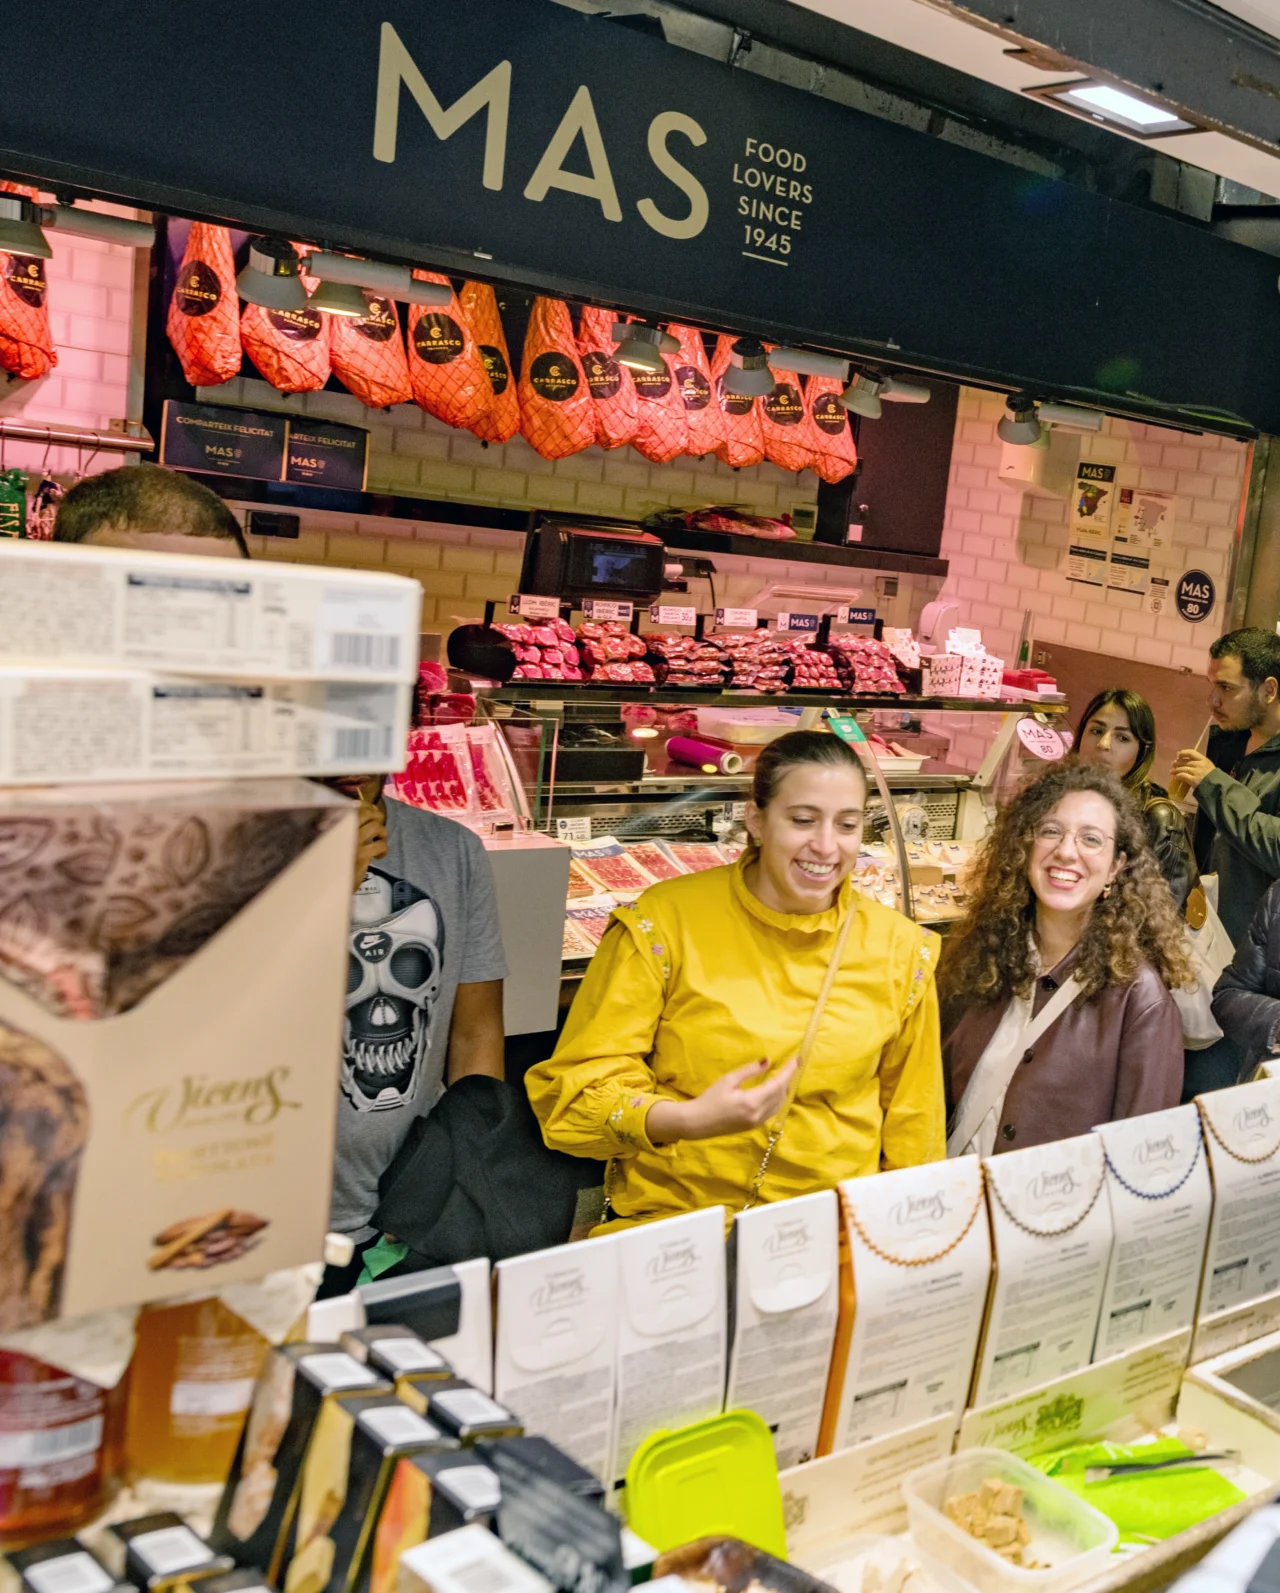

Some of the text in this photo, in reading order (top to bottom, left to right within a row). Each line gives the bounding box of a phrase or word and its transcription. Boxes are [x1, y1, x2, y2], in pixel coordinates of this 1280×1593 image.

[373, 21, 710, 240] MAS
[745, 137, 807, 173] FOOD
[732, 163, 813, 204] LOVERS
[737, 195, 803, 230] SINCE
[744, 225, 791, 254] 1945
[176, 286, 218, 301] CARRASCO
[416, 338, 462, 348] CARRASCO
[533, 377, 578, 386] CARRASCO
[815, 413, 846, 421] CARRASCO
[175, 415, 275, 438] COMPARTEIX FELICITAT
[317, 436, 357, 449] FELICITAT
[205, 444, 234, 458] MAS
[290, 455, 318, 469] MAS
[1081, 466, 1104, 479] MAS
[1181, 580, 1210, 599] MAS
[1187, 603, 1200, 614] 80
[850, 611, 868, 621] MAS
[791, 618, 810, 628] MAS
[1022, 728, 1053, 739] MAS
[1040, 745, 1054, 753] 80
[575, 849, 606, 859] MAS
[365, 948, 385, 957] AIR
